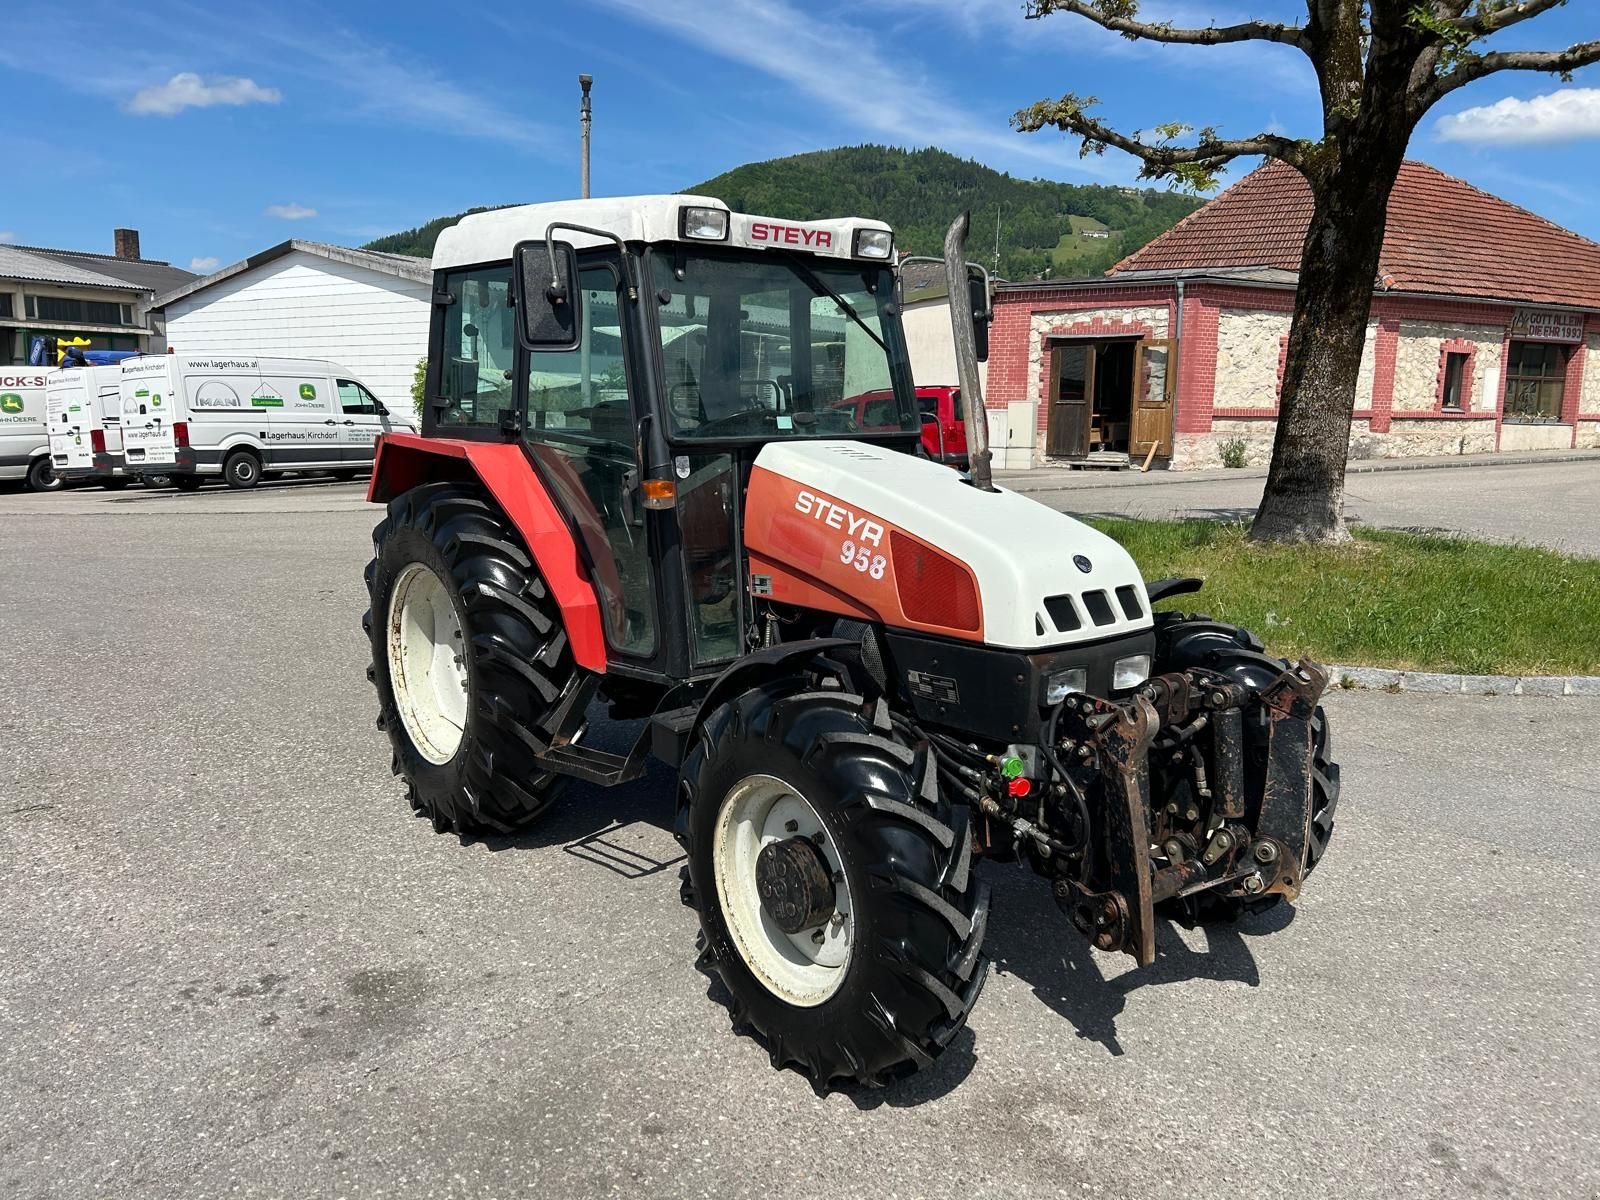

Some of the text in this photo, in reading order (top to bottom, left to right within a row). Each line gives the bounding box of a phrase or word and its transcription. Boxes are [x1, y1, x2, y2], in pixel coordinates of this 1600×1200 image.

[752, 223, 832, 248] STEYR
[1530, 313, 1583, 327] GOTT ALLEIN
[1529, 325, 1543, 337] DIE
[1562, 327, 1582, 339] 1993
[187, 360, 258, 369] www.lagerhaus.at
[0, 377, 47, 386] CK-S
[200, 398, 237, 406] MAN
[267, 431, 305, 440] Lagerhaus
[307, 431, 338, 439] Kirchdorf
[795, 490, 884, 547] STEYR
[840, 540, 887, 580] 958
